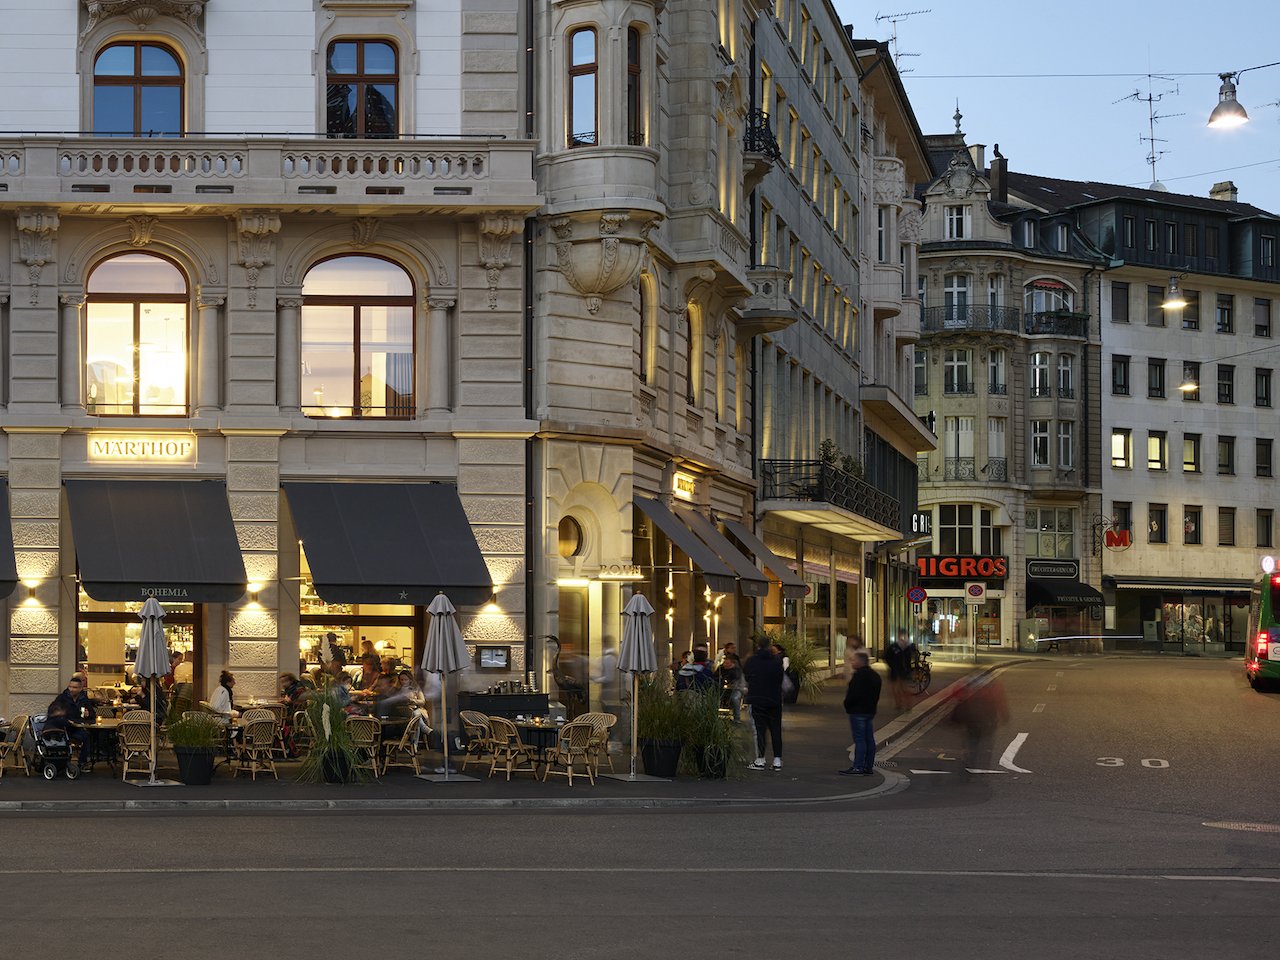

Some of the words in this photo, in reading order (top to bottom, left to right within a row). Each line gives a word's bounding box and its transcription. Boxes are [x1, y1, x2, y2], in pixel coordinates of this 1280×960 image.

[94, 441, 191, 456] MÄRTHOF
[141, 588, 188, 597] BOHEMIA
[1096, 757, 1170, 769] 30
